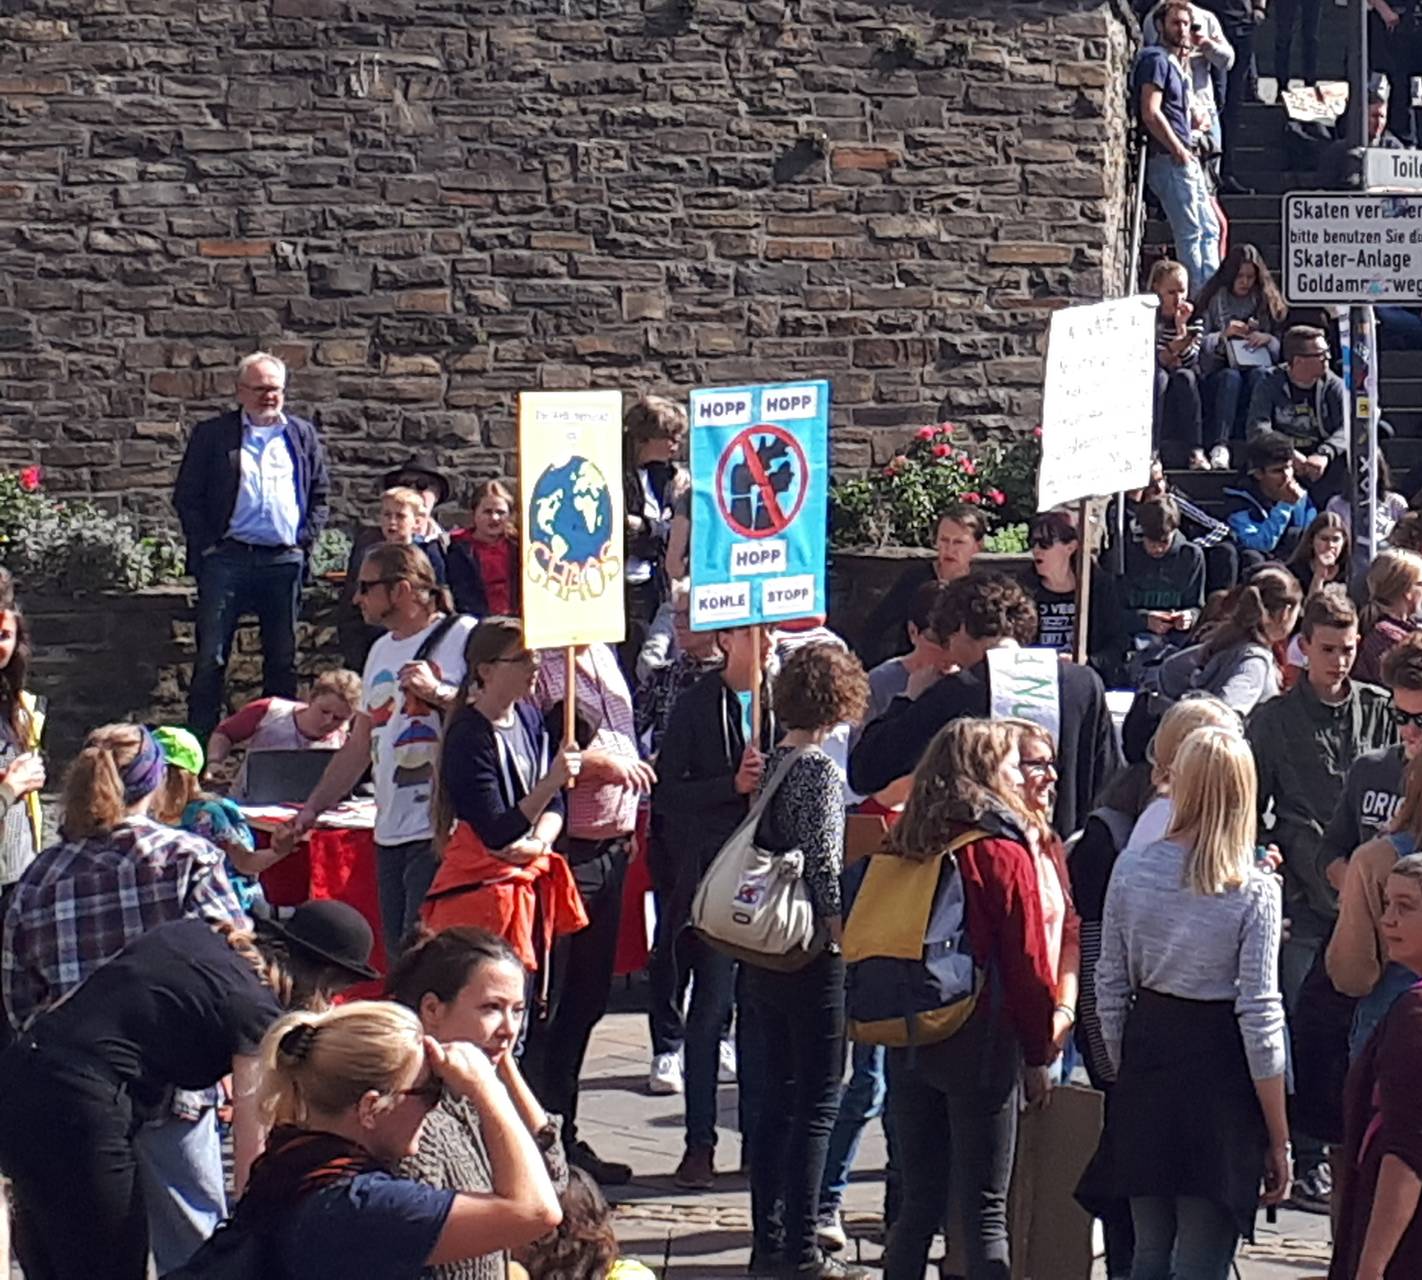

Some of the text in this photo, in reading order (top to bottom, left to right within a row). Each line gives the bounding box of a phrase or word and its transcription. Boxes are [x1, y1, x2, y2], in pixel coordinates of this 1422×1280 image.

[1293, 201, 1350, 220] Skaten
[1290, 229, 1319, 244] bitte
[1323, 229, 1382, 244] benutzen
[1386, 228, 1405, 244] Sie
[1293, 249, 1412, 272] Skater-Anlage
[699, 394, 812, 419] HOPP HOPP
[735, 549, 781, 568] HOPP
[699, 586, 810, 611] KOHLE STOPP
